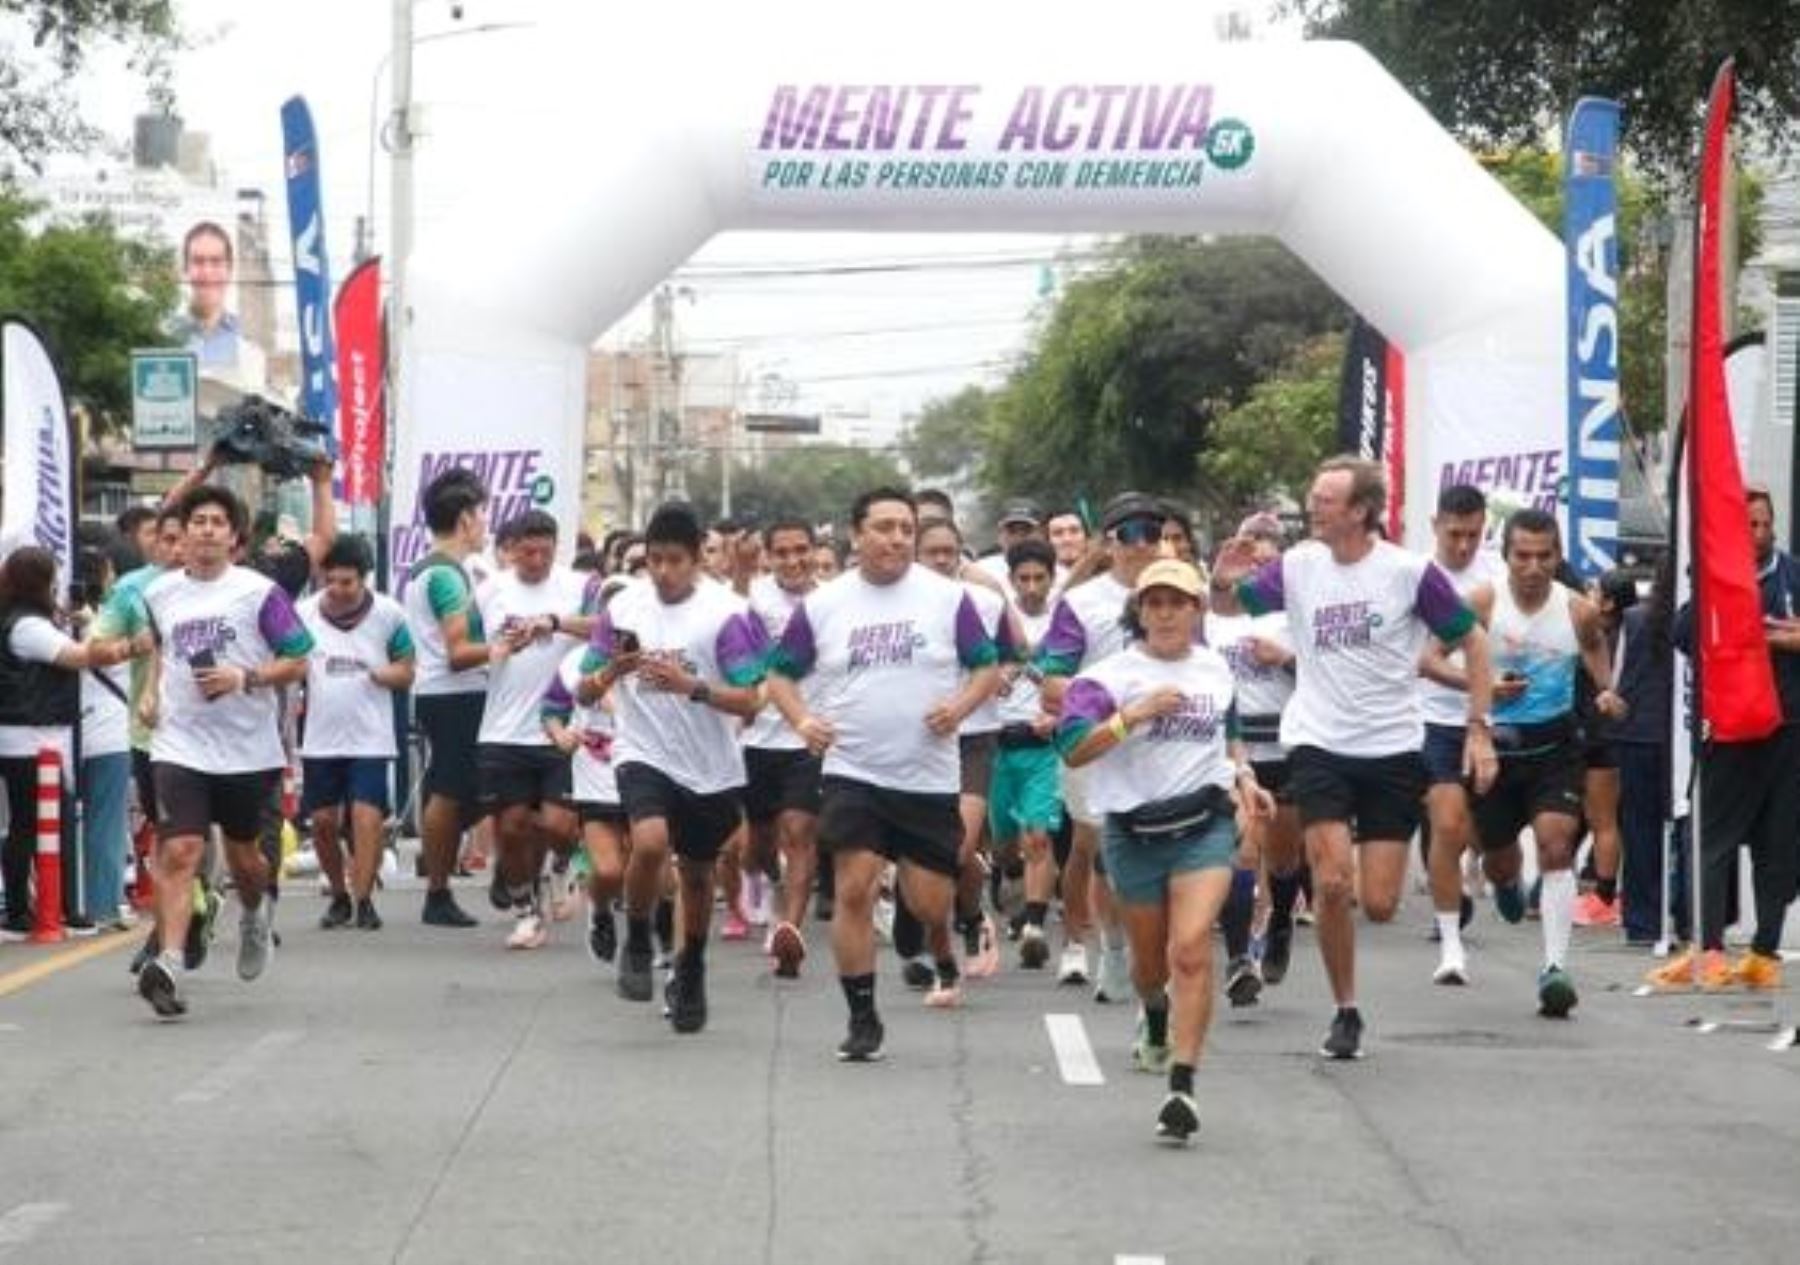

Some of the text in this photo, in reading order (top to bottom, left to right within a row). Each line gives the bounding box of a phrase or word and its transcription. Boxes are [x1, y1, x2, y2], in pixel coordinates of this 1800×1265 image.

[759, 84, 1214, 150] MENTE ACTIVA
[764, 159, 1204, 188] POR LAS PERSONAS CON DEMENCIA
